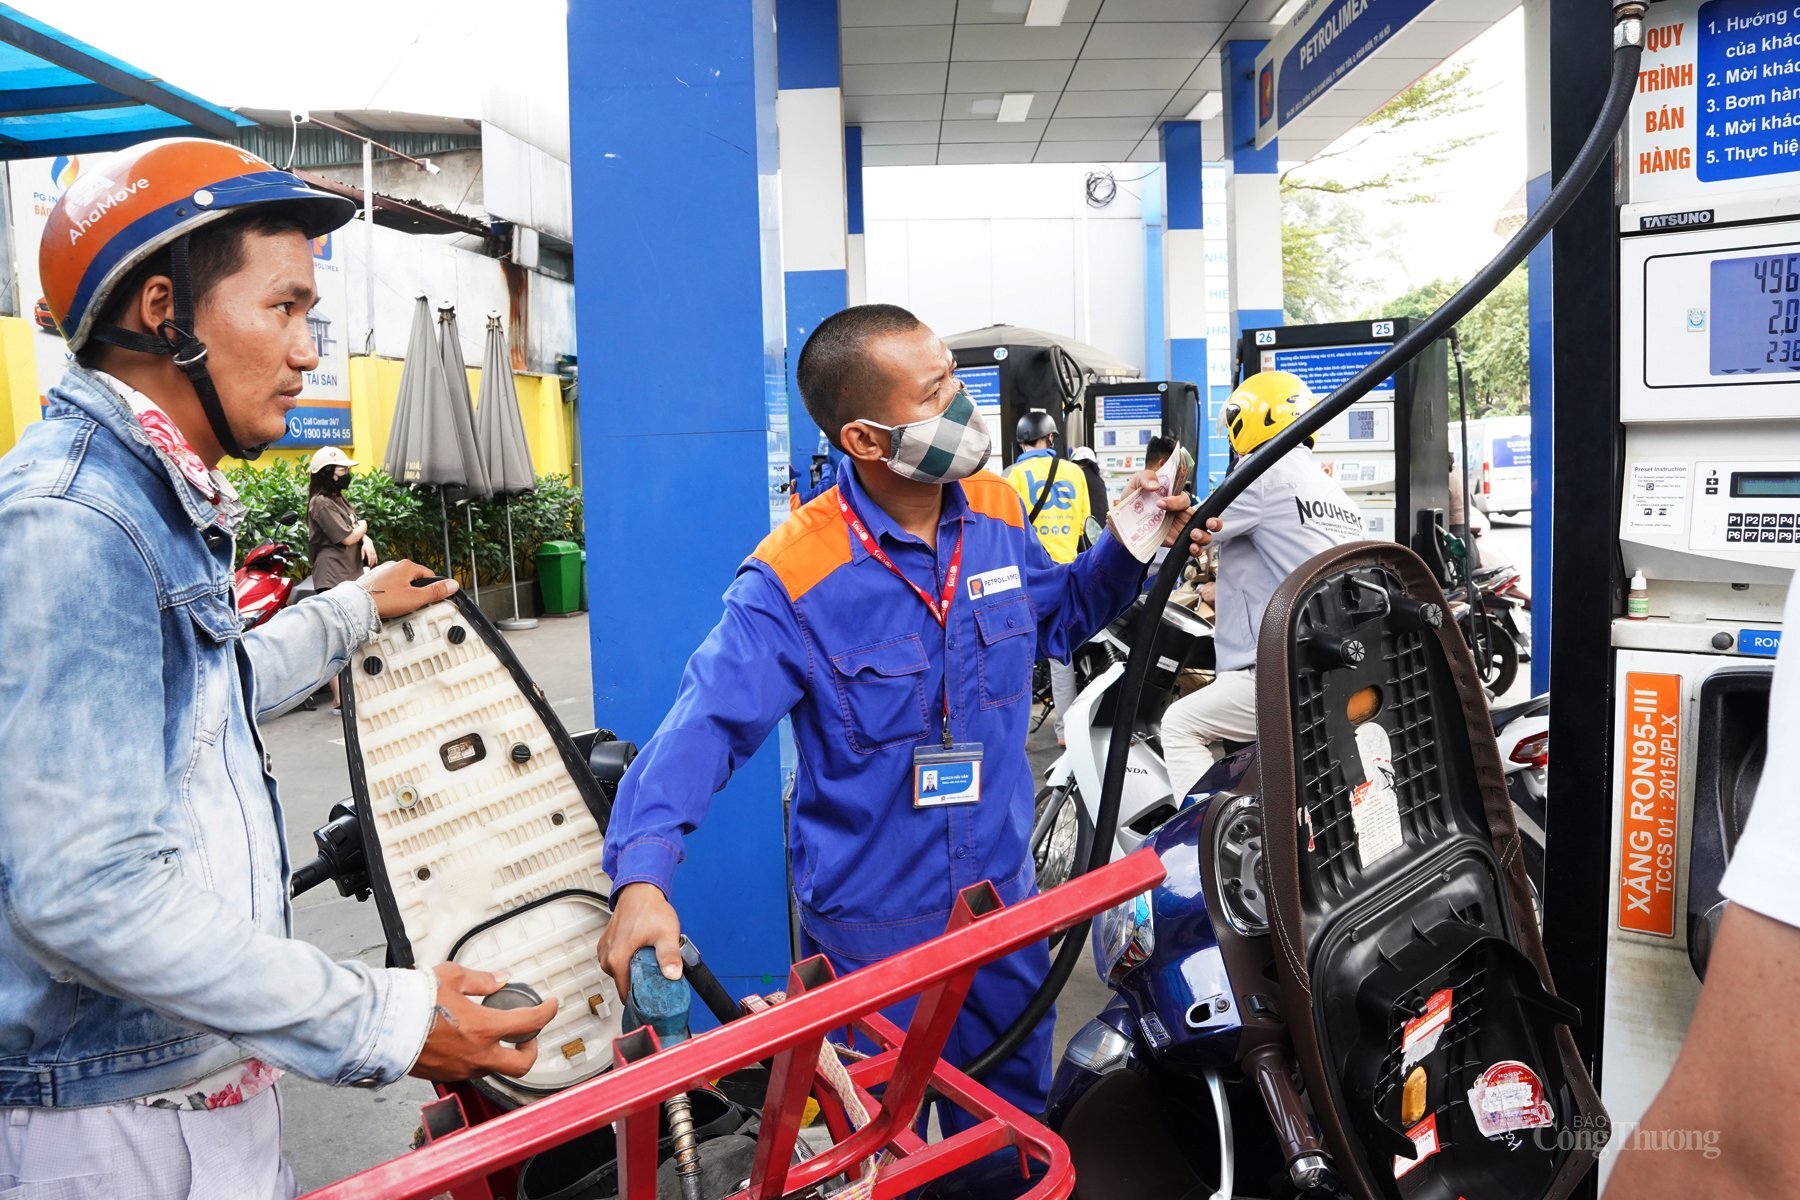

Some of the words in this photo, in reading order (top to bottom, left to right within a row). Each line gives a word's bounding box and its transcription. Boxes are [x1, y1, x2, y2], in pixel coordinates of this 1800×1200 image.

[1708, 21, 1721, 35] 1.
[1727, 10, 1787, 31] Hướng
[1645, 23, 1684, 52] QUY
[1726, 42, 1756, 57] của
[1638, 63, 1693, 93] TRÌNH
[1707, 73, 1720, 87] 2.
[1726, 66, 1757, 84] Mời
[1707, 99, 1719, 112] 3.
[1726, 94, 1765, 110] Bơm
[1646, 105, 1684, 133] BÁN
[1706, 124, 1719, 137] 4.
[1725, 118, 1756, 136] Mời
[1640, 147, 1690, 174] HÀNG
[1706, 150, 1719, 163] 5.
[1725, 146, 1767, 161] Thực
[69, 178, 149, 245] AhaMove
[1643, 211, 1711, 228] TATSUNO
[1754, 257, 1799, 293] 496
[1259, 332, 1272, 343] 26
[1376, 323, 1391, 335] 25
[996, 350, 1006, 358] 27
[303, 417, 312, 425] Call
[303, 428, 321, 438] 1900
[322, 428, 330, 438] 54
[332, 428, 340, 438] 54
[342, 428, 351, 439] 55
[1024, 470, 1077, 510] be
[1729, 516, 1741, 524] P1
[1746, 516, 1759, 524] P2
[1763, 516, 1775, 524] P3
[1780, 517, 1793, 525] P4
[1728, 531, 1741, 539] P6
[1745, 532, 1757, 540] P7
[1762, 532, 1774, 540] P8
[1779, 532, 1792, 540] P9
[1630, 689, 1658, 821] RON95-III
[1659, 714, 1677, 799] 2015/PLX
[1658, 818, 1674, 837] 01
[1622, 830, 1654, 914] XĂNG
[1655, 842, 1674, 894] TCCS
